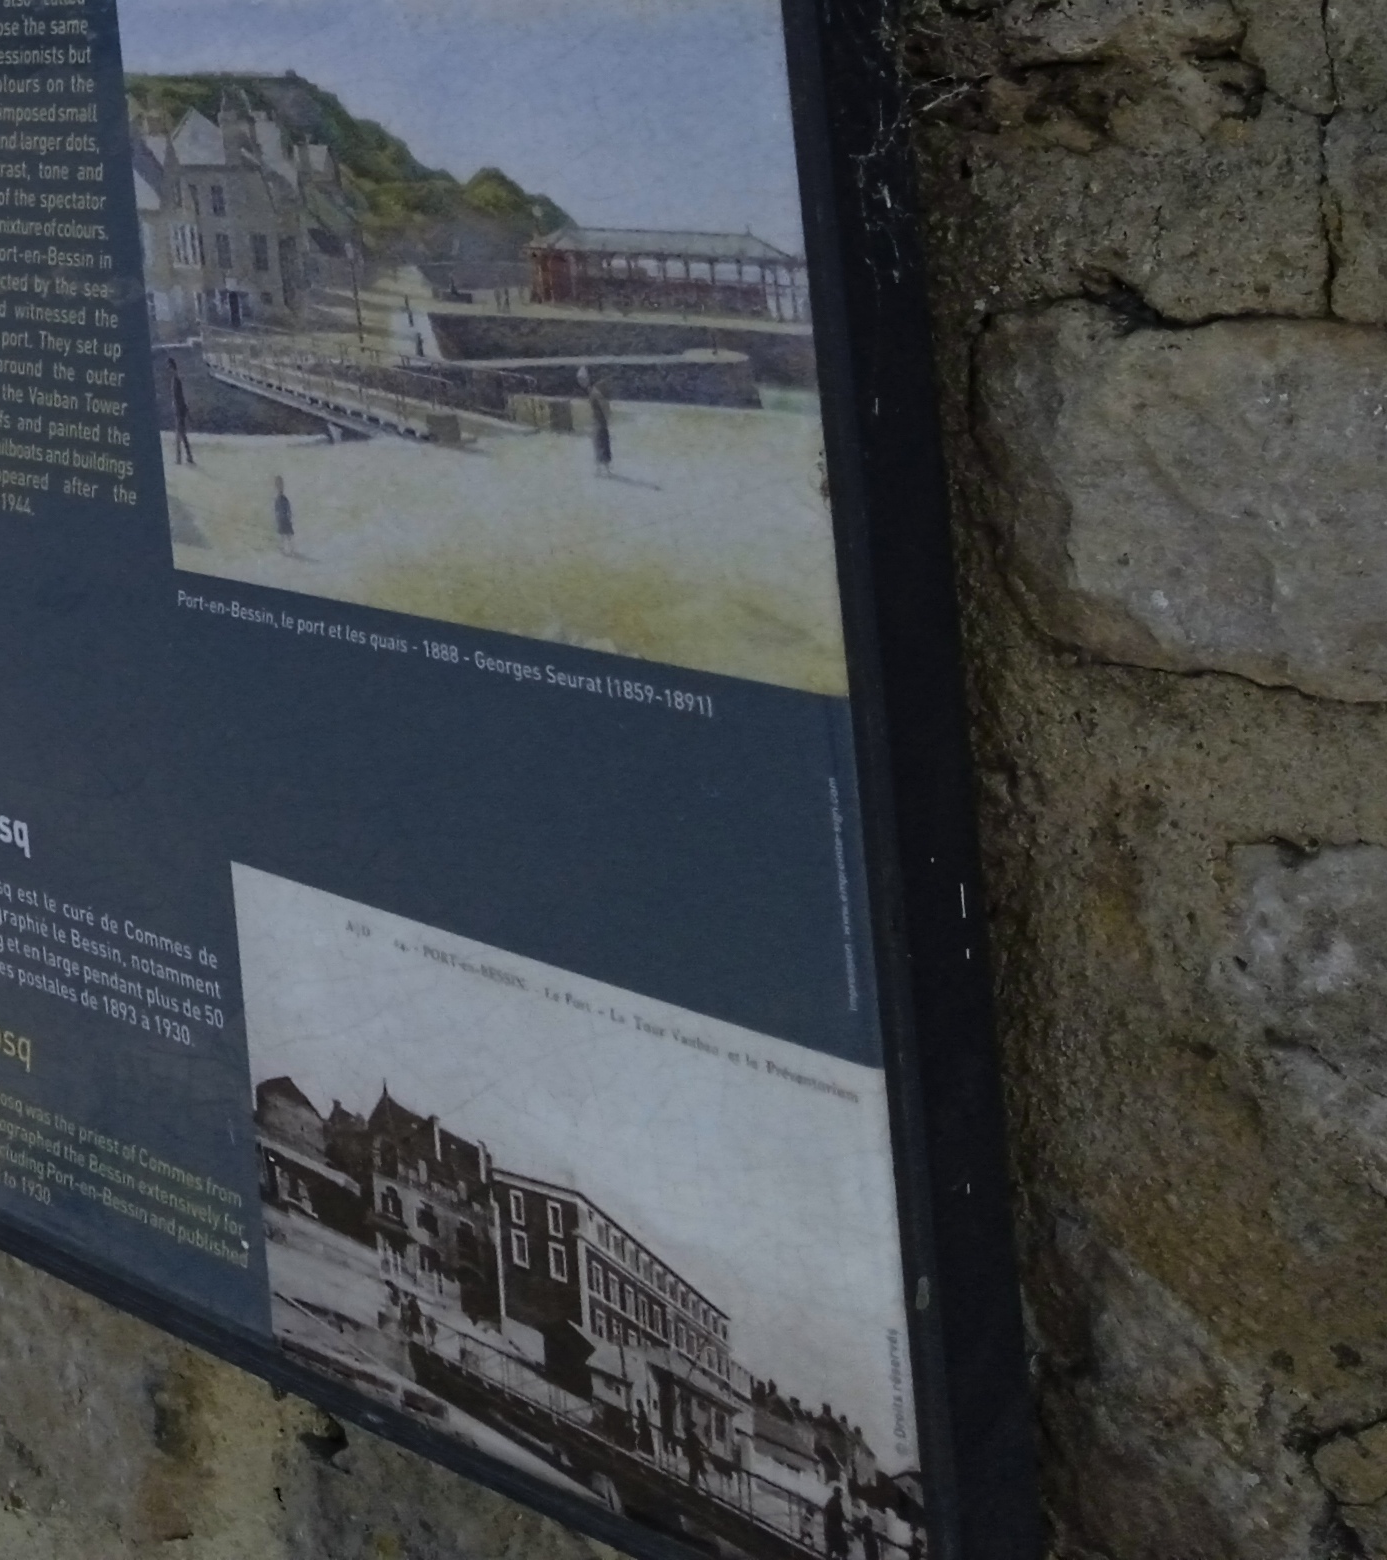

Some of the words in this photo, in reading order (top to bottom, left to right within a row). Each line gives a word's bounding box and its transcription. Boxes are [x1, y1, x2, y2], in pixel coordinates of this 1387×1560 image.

[67, 44, 92, 65] but
[46, 77, 65, 94] on
[70, 73, 95, 94] the
[38, 161, 70, 181] tone
[76, 161, 105, 183] and
[98, 254, 113, 270] in
[38, 329, 72, 358] They
[75, 337, 99, 356] set
[102, 342, 123, 363] up
[52, 361, 76, 383] the
[85, 367, 126, 387] outer
[1, 383, 24, 404] the
[28, 385, 79, 411] Vauban
[84, 391, 129, 417] Tower
[1, 491, 35, 517] 1944.
[177, 589, 279, 629] Port-en-Bessin,
[280, 611, 294, 630] le
[296, 618, 326, 637] port
[327, 623, 342, 640] et
[345, 624, 367, 645] les
[369, 632, 409, 654] quais
[422, 639, 460, 664] 1888
[473, 649, 543, 682] Georges
[545, 663, 603, 694] Seurat
[606, 675, 713, 718] (1859-1891)
[16, 887, 39, 908] est
[42, 892, 57, 914] le
[61, 902, 95, 927] curé
[99, 912, 119, 935] de
[123, 919, 193, 961] Commes
[197, 946, 218, 970] de
[51, 922, 67, 945] le
[69, 927, 127, 968] Bessin,
[130, 954, 222, 1000] notamment
[6, 936, 21, 955] et
[22, 943, 41, 962] en
[41, 945, 80, 978] large
[82, 964, 144, 1001] pendant
[145, 986, 180, 1014] plus
[182, 998, 202, 1022] de
[203, 1003, 225, 1030] 50
[17, 967, 78, 1003] postales
[79, 988, 99, 1011] de
[102, 994, 138, 1026] 1893
[154, 1014, 196, 1048] 1930.
